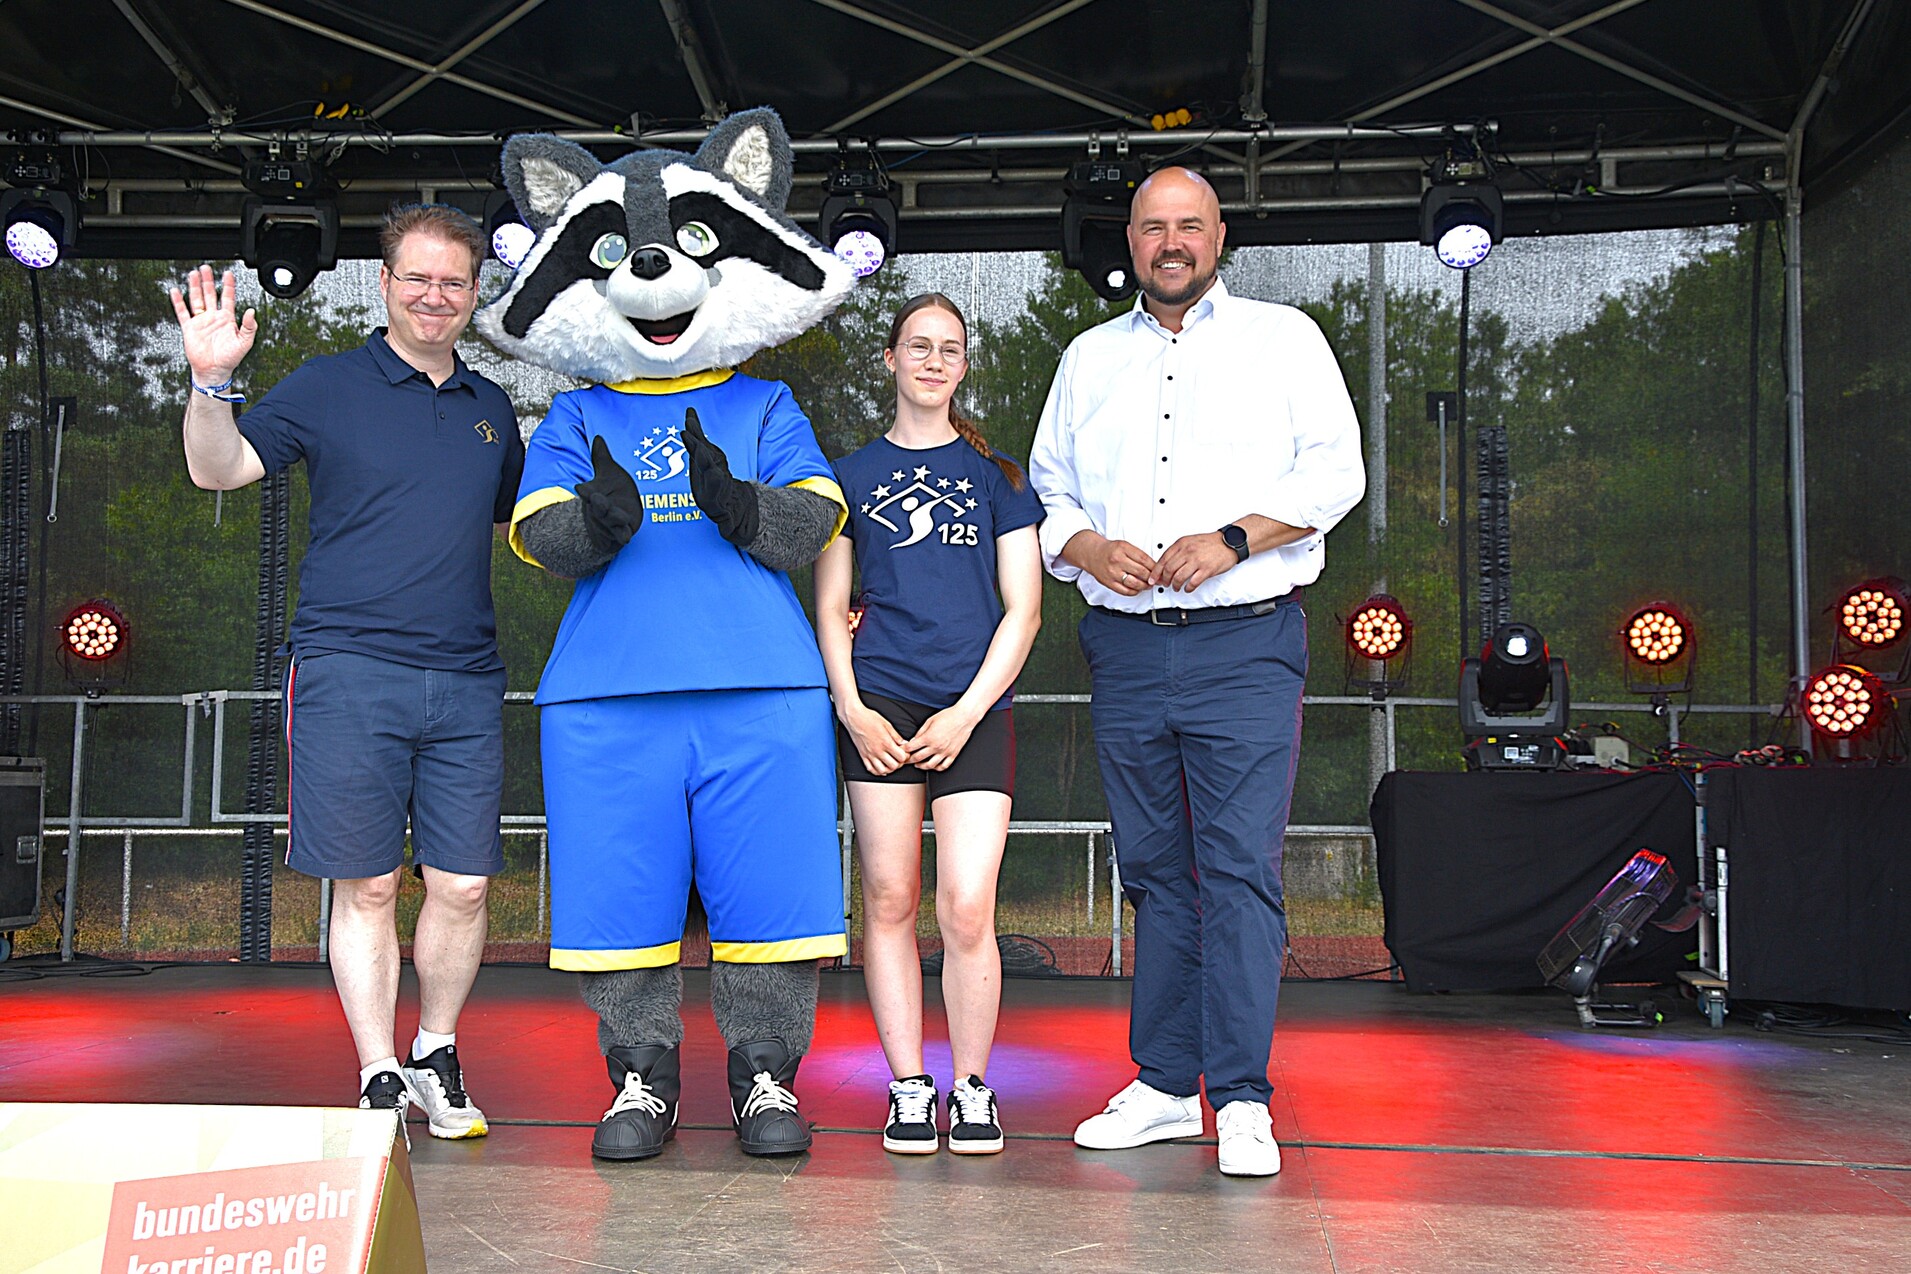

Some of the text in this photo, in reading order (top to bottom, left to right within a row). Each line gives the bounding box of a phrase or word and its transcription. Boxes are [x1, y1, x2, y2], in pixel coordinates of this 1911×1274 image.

[635, 470, 658, 480] 125
[651, 510, 703, 522] Berlin e.V.
[937, 523, 979, 546] 125
[133, 1181, 356, 1241] bundeswehr
